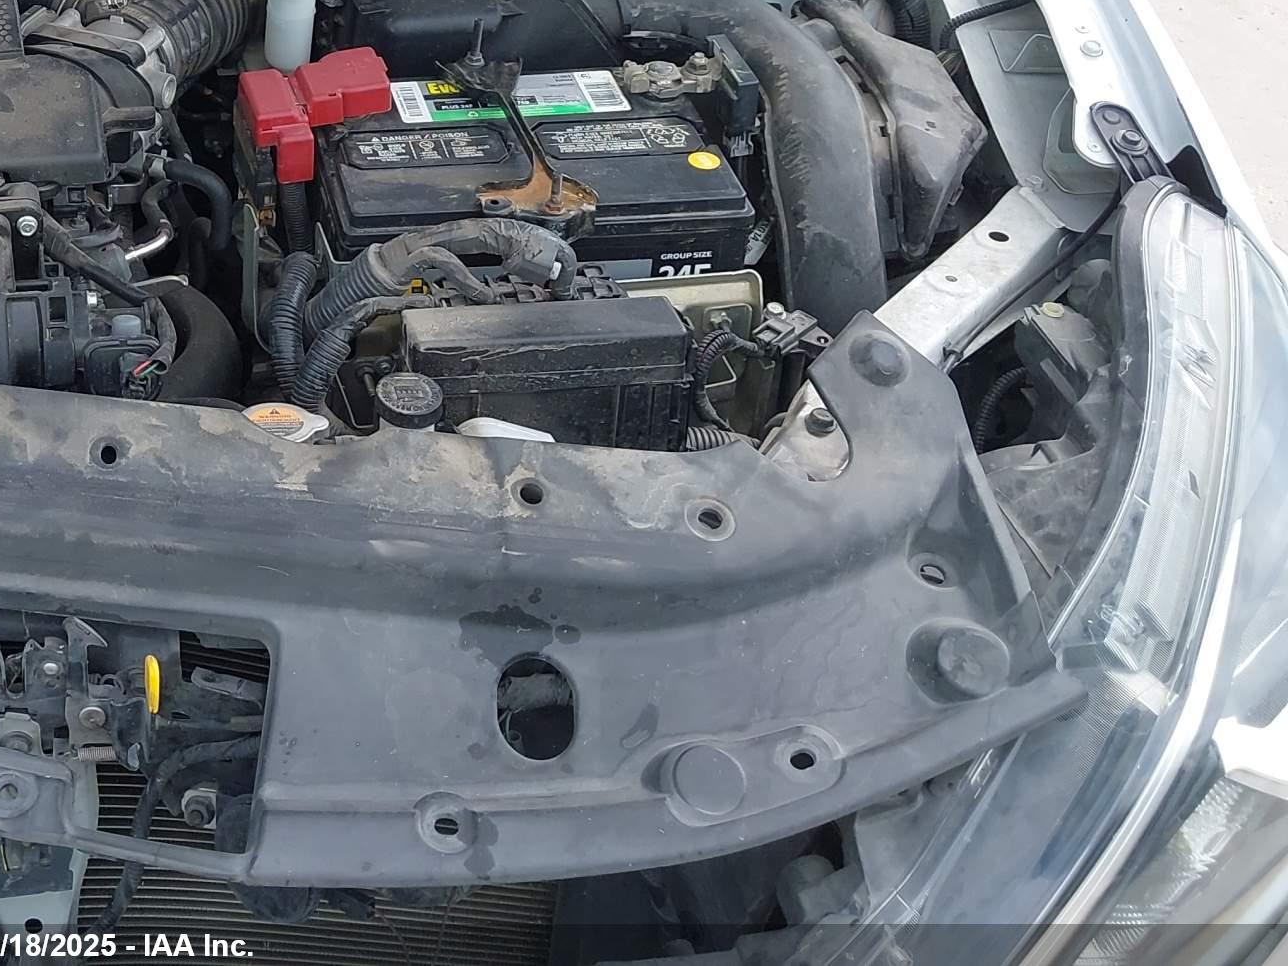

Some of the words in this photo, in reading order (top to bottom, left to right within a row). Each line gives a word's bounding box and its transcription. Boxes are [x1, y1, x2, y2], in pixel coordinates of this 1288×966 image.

[381, 134, 422, 142] DANGER
[432, 131, 469, 139] POISON
[660, 252, 692, 260] GROUP
[693, 251, 712, 259] SIZE
